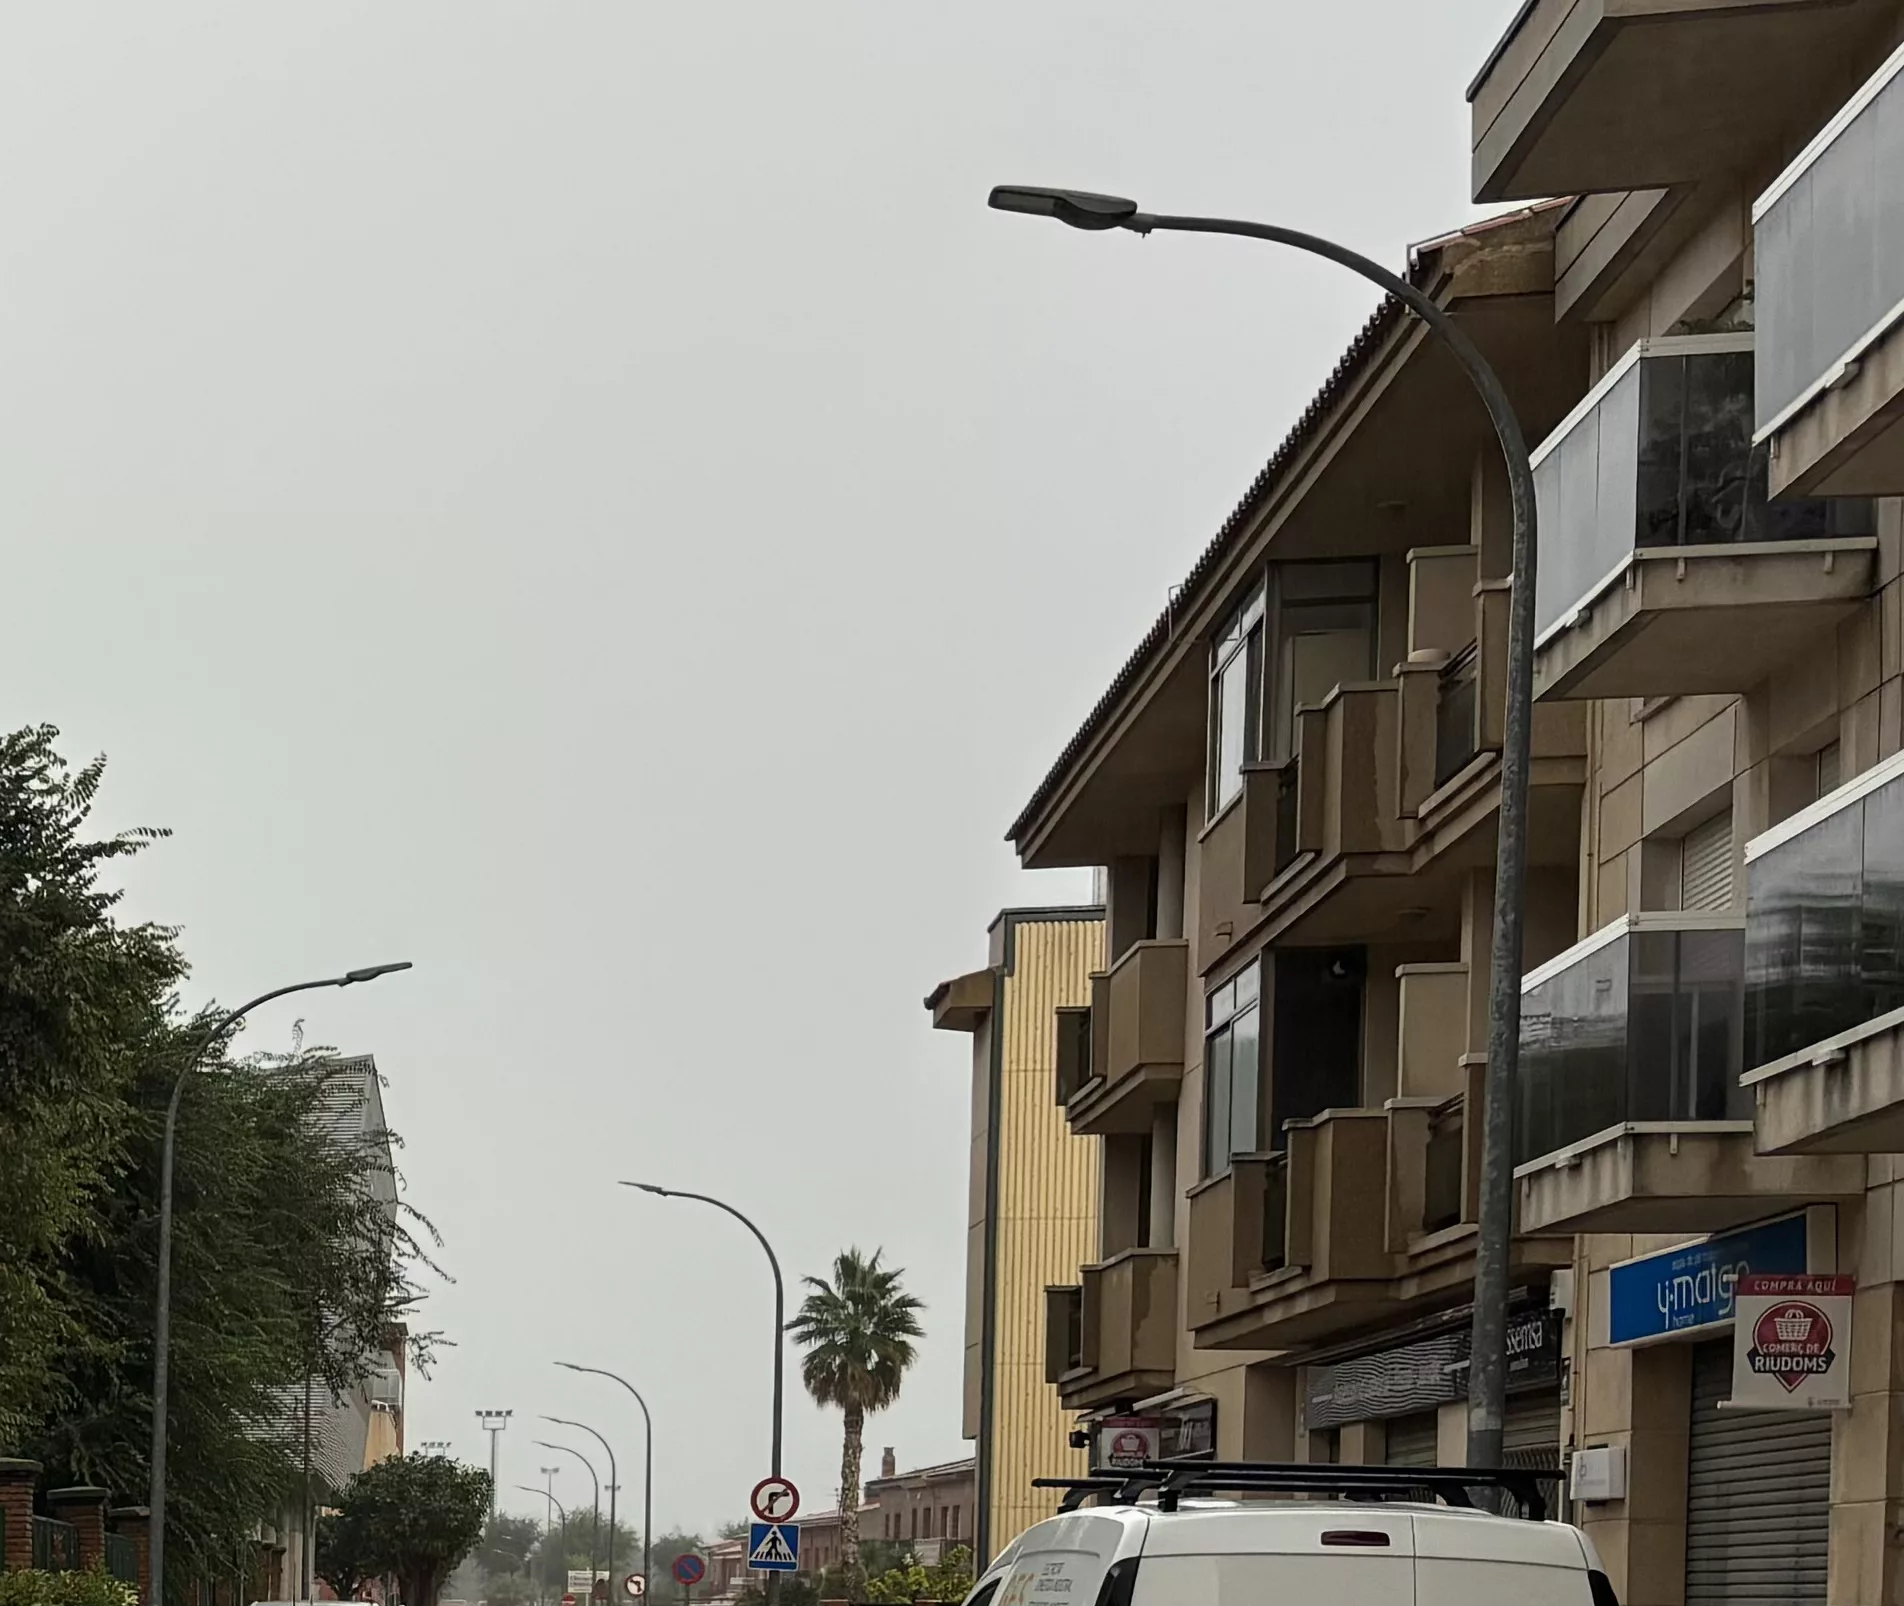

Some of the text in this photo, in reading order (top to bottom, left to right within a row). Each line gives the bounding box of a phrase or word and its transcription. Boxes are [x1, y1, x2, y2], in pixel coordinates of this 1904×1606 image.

[1754, 1278, 1837, 1293] COMPRA AQUÍ
[1762, 1343, 1821, 1355] COMERÇ DE
[1754, 1356, 1827, 1371] RIUDOMS
